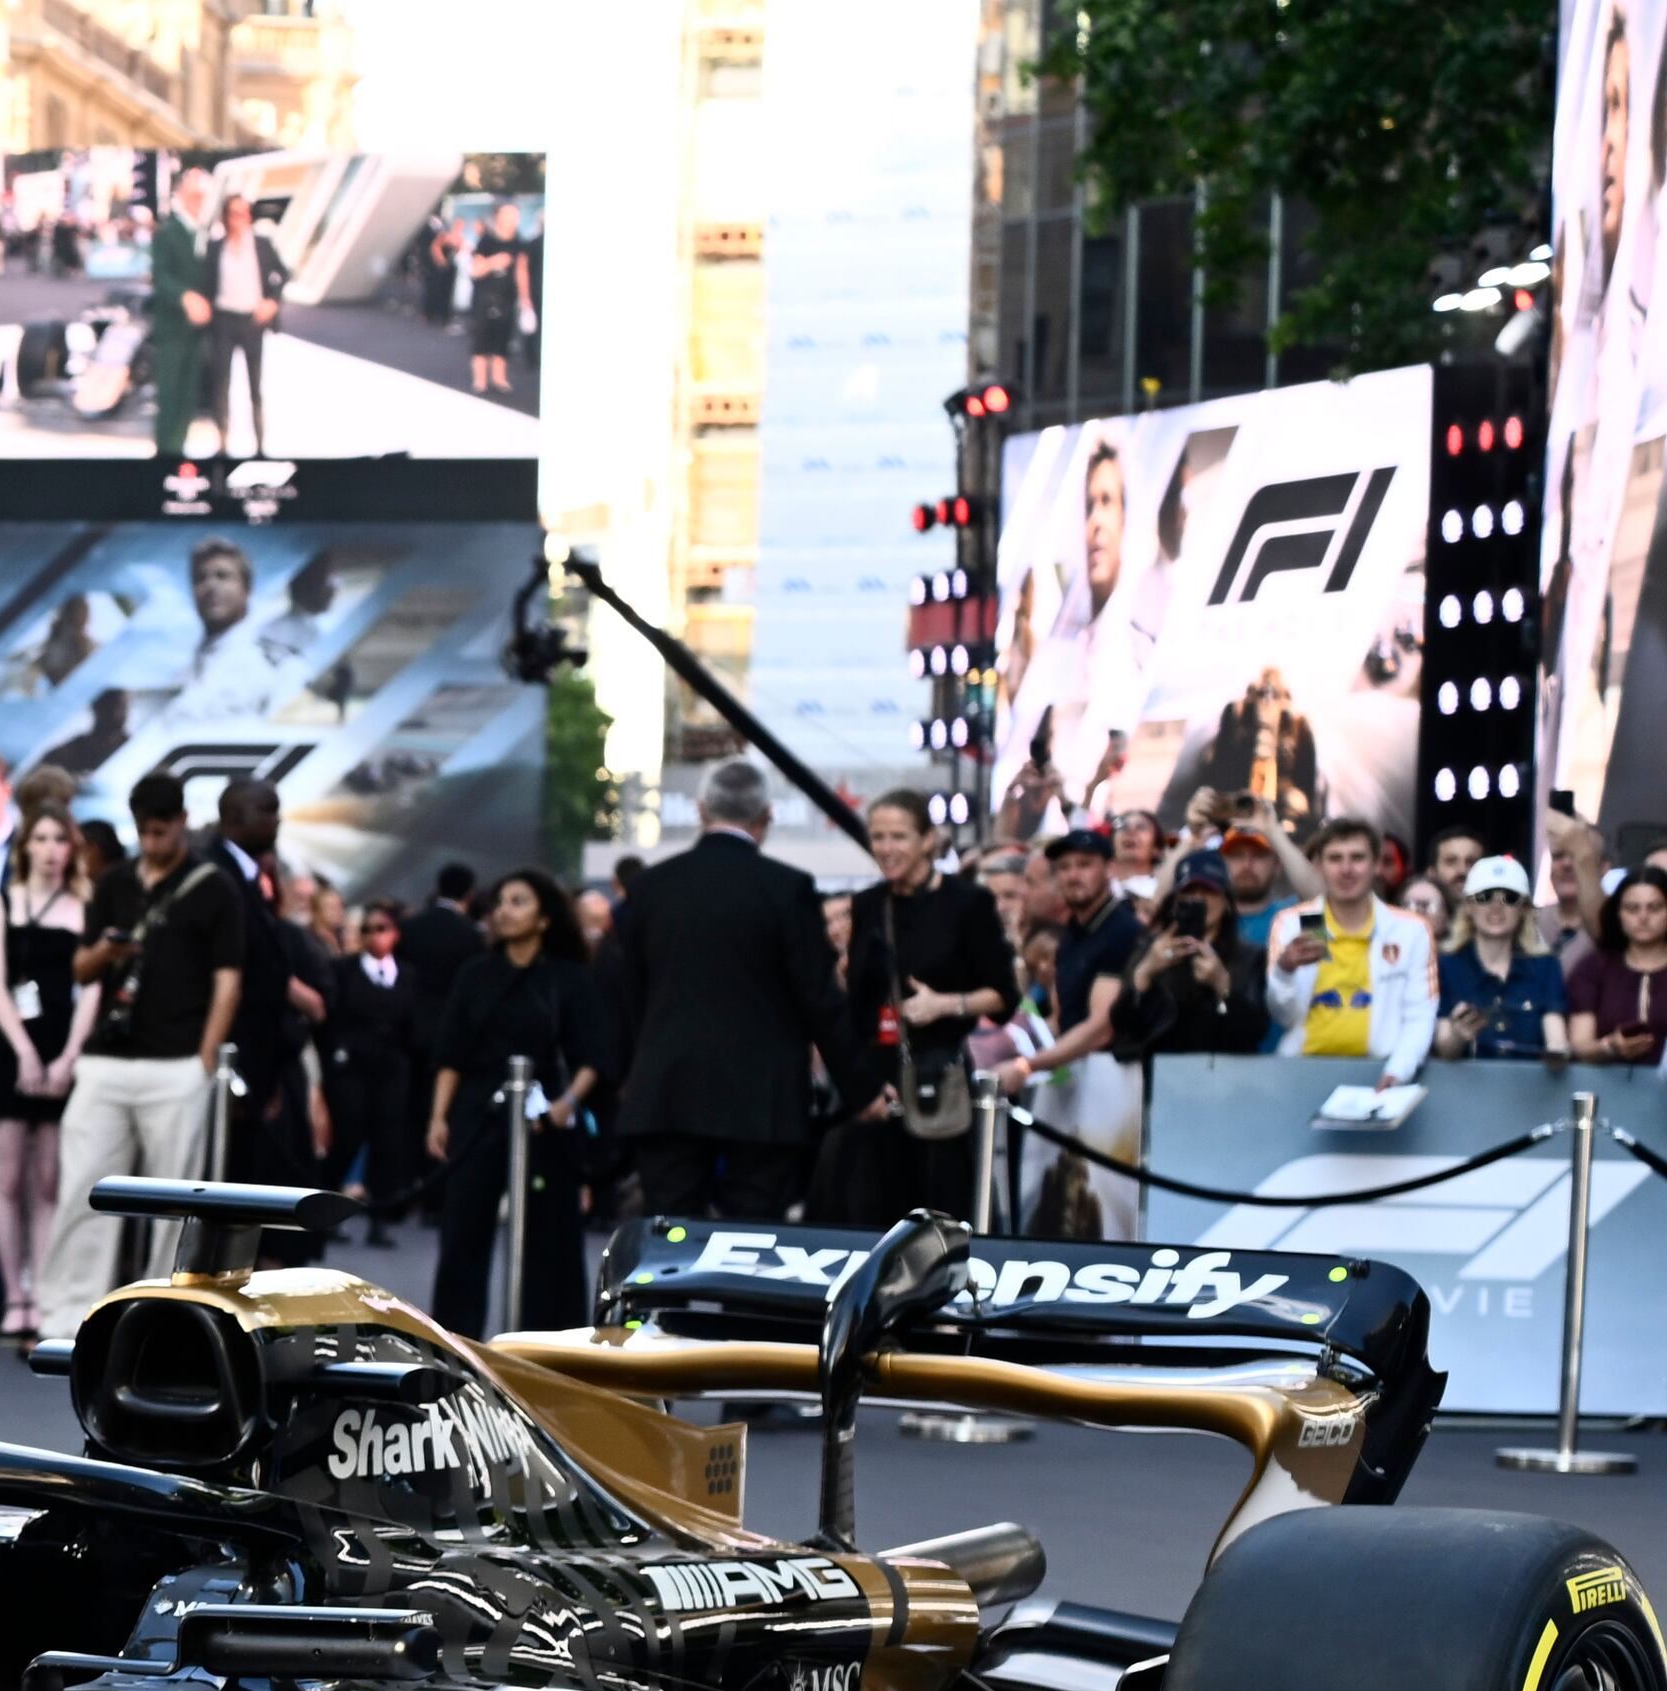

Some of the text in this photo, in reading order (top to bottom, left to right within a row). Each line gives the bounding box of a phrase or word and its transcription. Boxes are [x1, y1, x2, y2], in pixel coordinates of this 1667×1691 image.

[1206, 466, 1399, 606] F1
[1430, 1285, 1535, 1318] VIE
[327, 1402, 460, 1480] Shark
[1298, 1416, 1357, 1448] GEICO
[1567, 1566, 1627, 1613] PIRELLI
